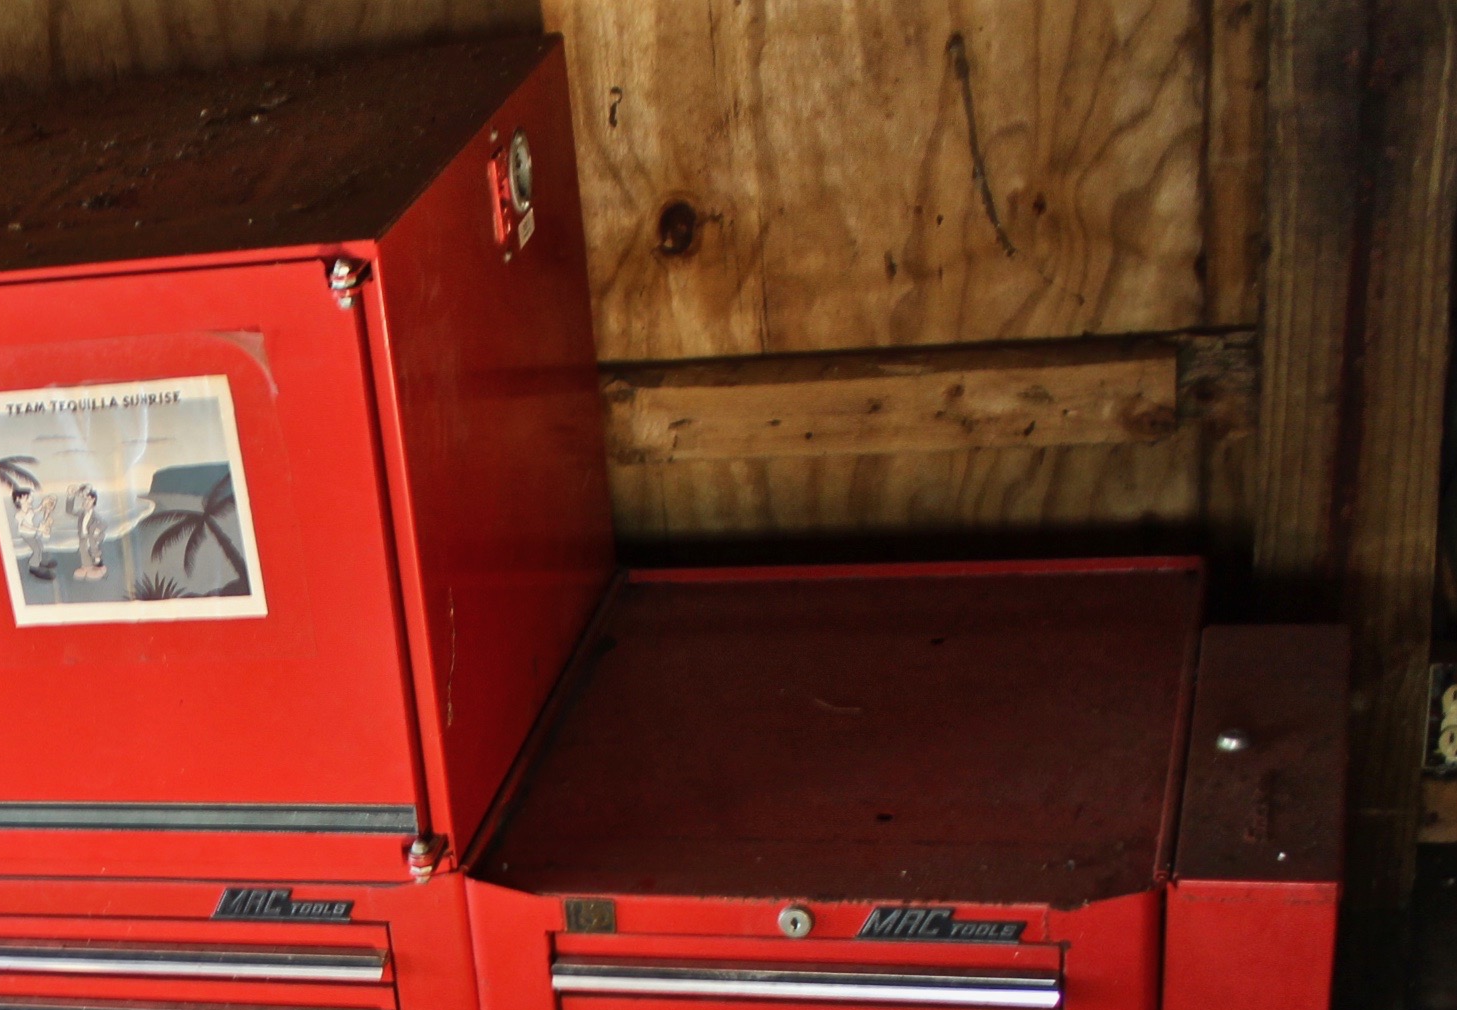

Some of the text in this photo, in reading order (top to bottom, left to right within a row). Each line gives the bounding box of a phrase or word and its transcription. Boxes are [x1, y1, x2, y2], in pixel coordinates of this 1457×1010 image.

[6, 391, 181, 416] TEAM TEQUILLA SUNRISE
[216, 889, 346, 916] MAC TOOLS
[860, 908, 1018, 937] MAC TOOLS
